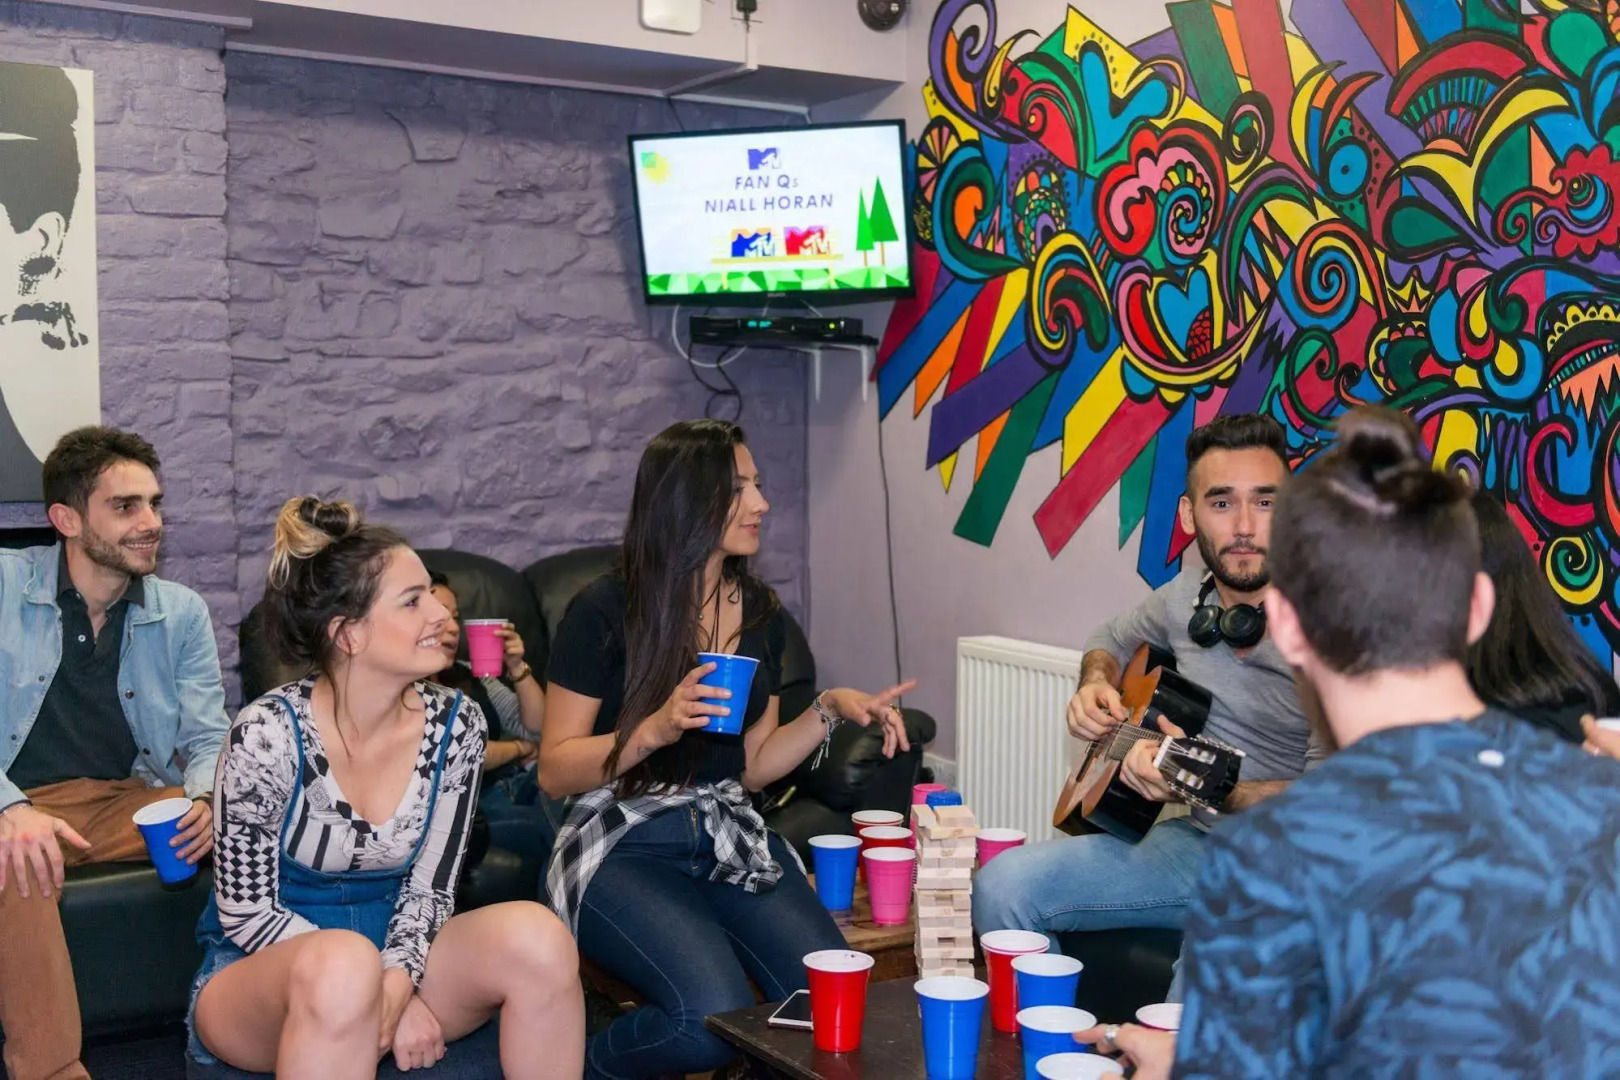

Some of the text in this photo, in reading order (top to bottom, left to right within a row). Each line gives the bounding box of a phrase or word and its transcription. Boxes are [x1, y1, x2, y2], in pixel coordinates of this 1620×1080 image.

[735, 174, 799, 190] FAN Qs
[704, 193, 833, 213] NIALL HORAN
[731, 225, 831, 258] MTV MTV
